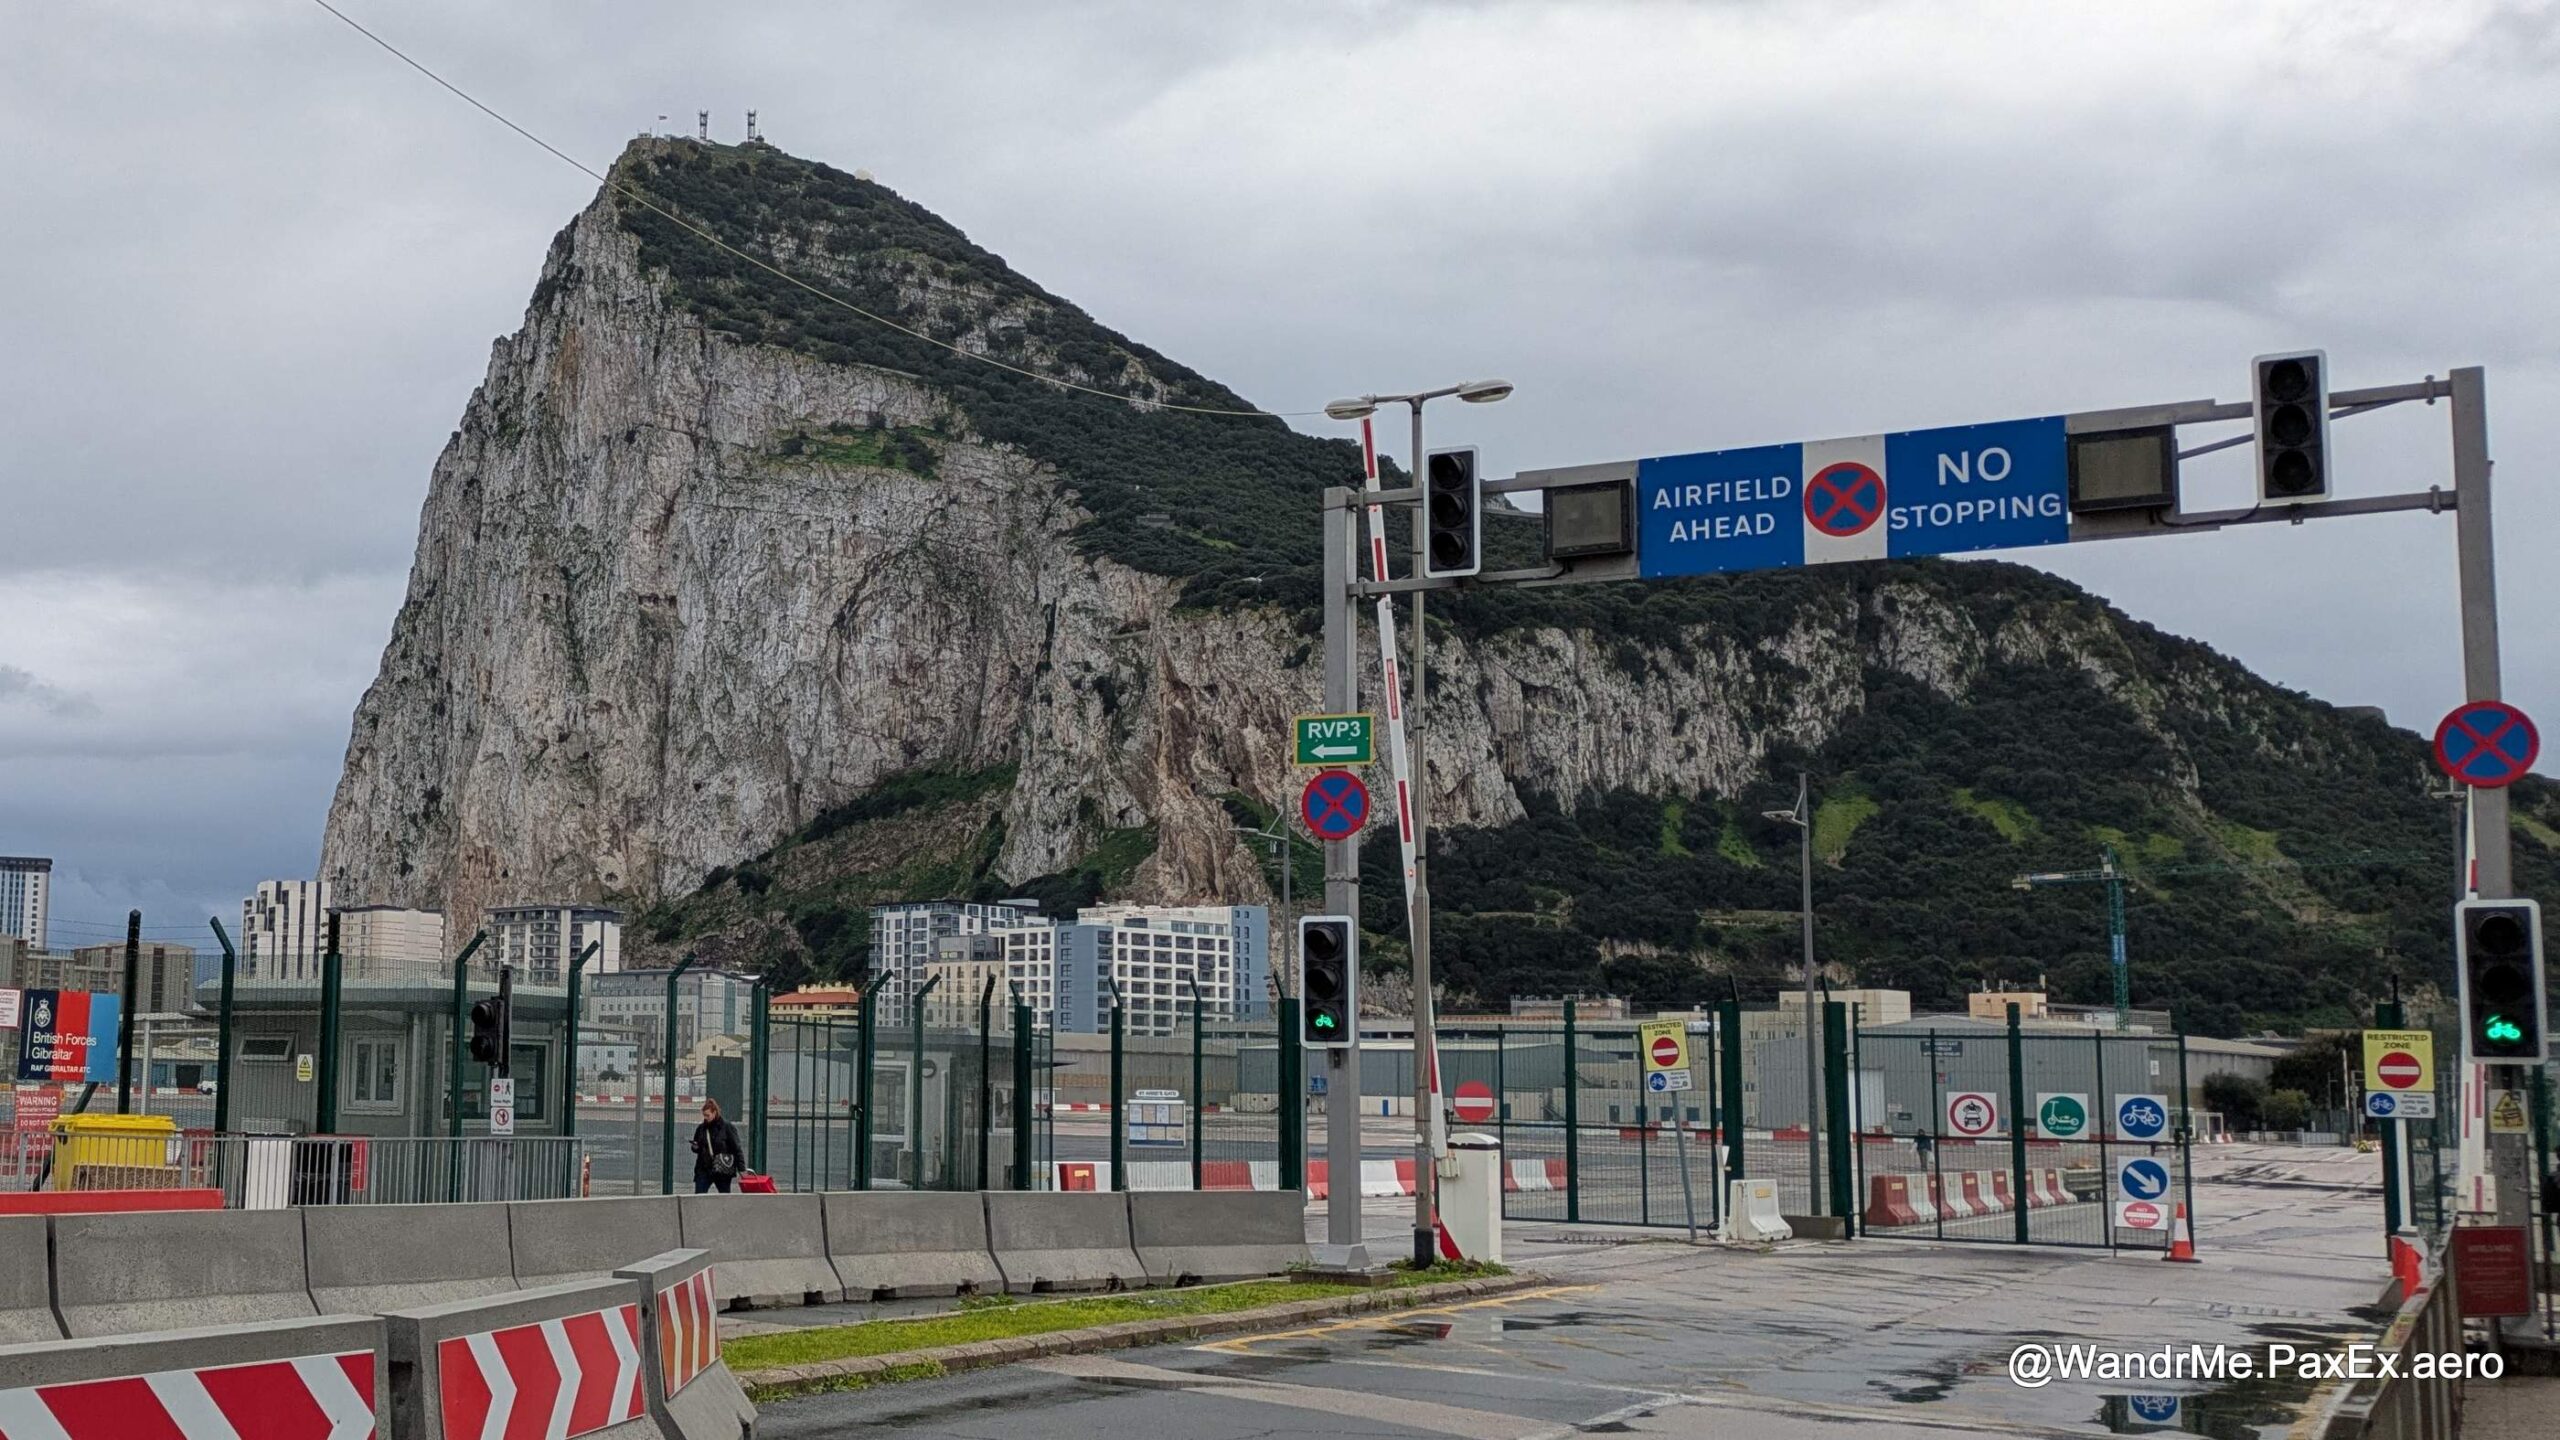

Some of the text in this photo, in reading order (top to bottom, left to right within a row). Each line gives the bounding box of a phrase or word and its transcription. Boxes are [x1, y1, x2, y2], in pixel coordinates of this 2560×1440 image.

[1937, 446, 2012, 486] NO
[1653, 475, 1792, 510] AIRFIELD
[1889, 492, 2063, 532] STOPPING
[1668, 511, 1776, 543] AHEAD
[1308, 720, 1361, 739] RVP3
[1643, 1022, 1681, 1030] RESTRICTED
[32, 1031, 97, 1046] British Forces
[2367, 1033, 2428, 1041] RESTRICTED
[31, 1046, 73, 1061] Gibraltar
[30, 1064, 91, 1074] RAF GIBRALTAR ATC
[19, 1096, 57, 1106] WARNING
